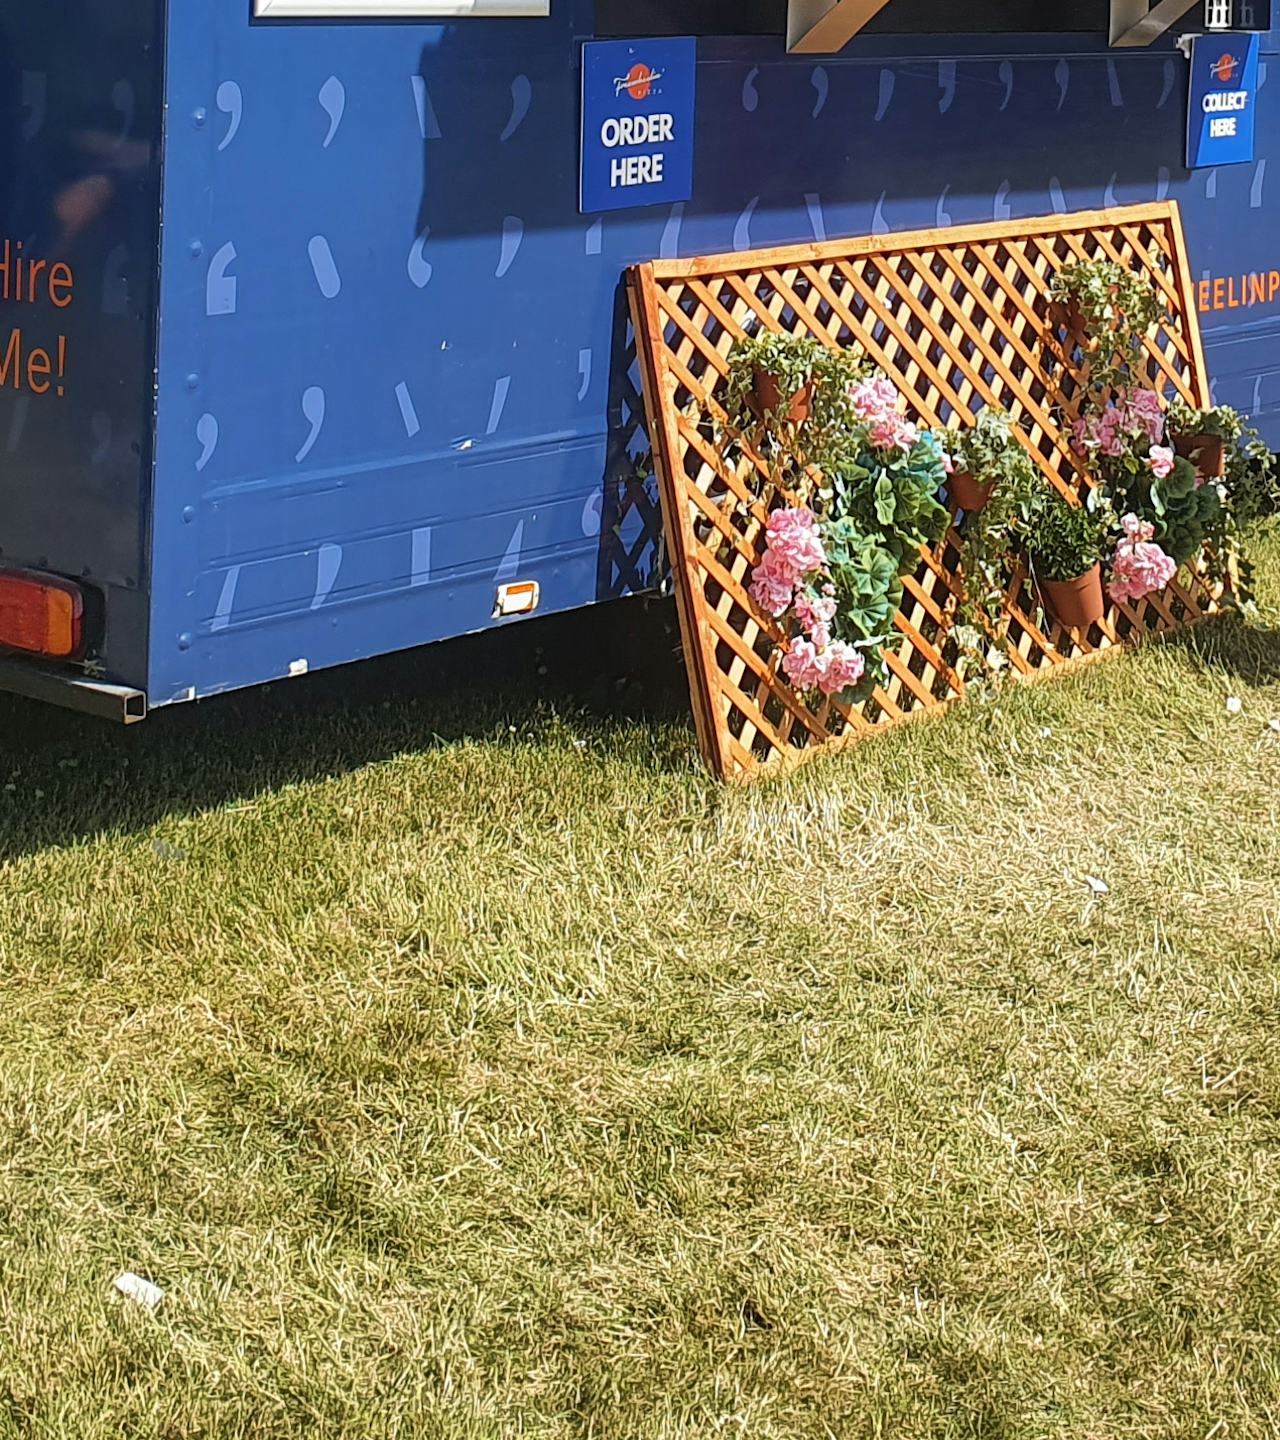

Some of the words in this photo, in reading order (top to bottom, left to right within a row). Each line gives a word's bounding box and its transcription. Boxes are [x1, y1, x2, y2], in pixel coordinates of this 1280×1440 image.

[1202, 91, 1248, 113] COLLECT
[601, 113, 674, 148] ORDER
[1209, 117, 1237, 138] HERE
[610, 153, 664, 188] HERE
